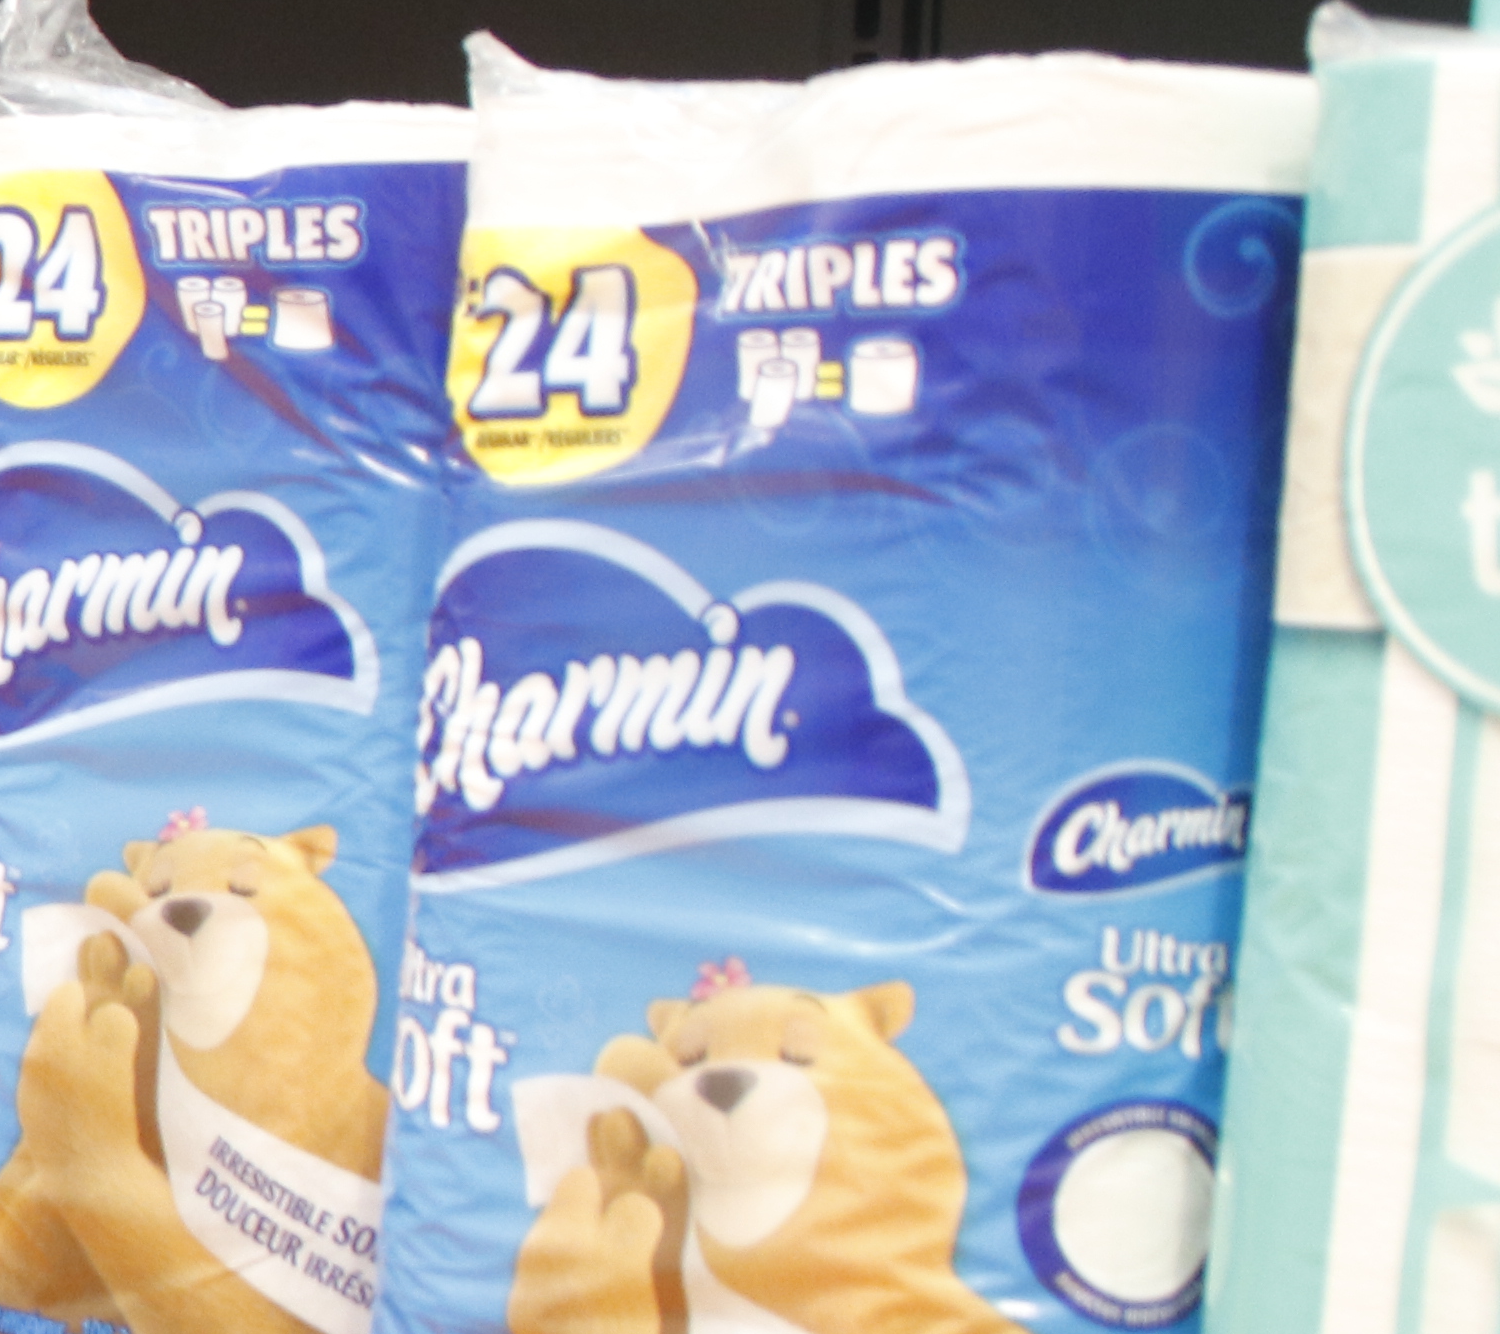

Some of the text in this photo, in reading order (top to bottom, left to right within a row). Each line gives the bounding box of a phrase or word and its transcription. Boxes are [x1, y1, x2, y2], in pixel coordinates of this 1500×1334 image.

[148, 204, 362, 262] TRIPLES
[726, 239, 959, 312] TRIPLES
[467, 264, 637, 420] 24
[415, 636, 796, 813] Charmin
[1053, 798, 1248, 877] Charmin
[1102, 925, 1228, 976] Ultra
[394, 1009, 508, 1133] oft
[195, 1166, 304, 1267] DOUCEUR
